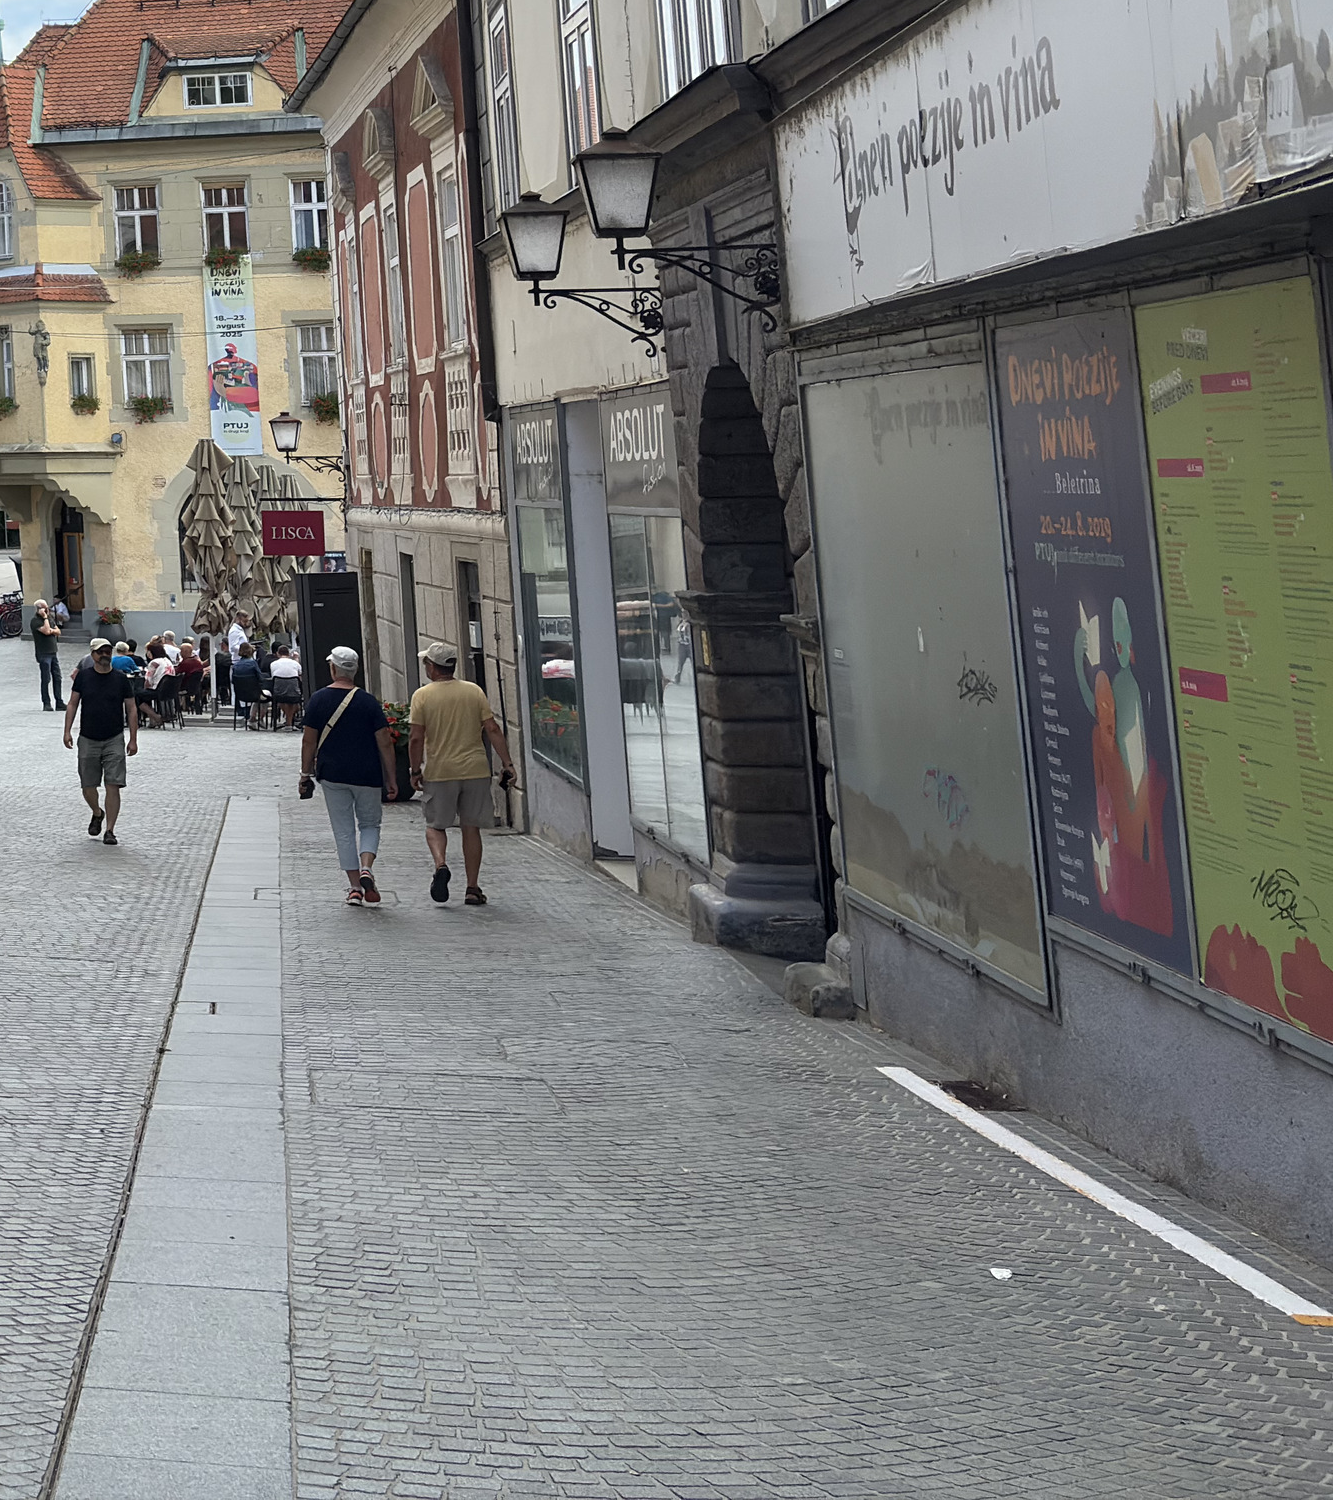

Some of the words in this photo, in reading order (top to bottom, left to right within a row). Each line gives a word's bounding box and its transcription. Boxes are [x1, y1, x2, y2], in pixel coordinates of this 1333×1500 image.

[897, 69, 964, 217] poezije
[968, 51, 995, 148] in
[997, 35, 1060, 143] vina
[516, 419, 553, 465] ABSOLUT
[610, 404, 665, 462] ABSOLUT
[271, 526, 315, 540] LISCA
[1087, 516, 1112, 543] 2019
